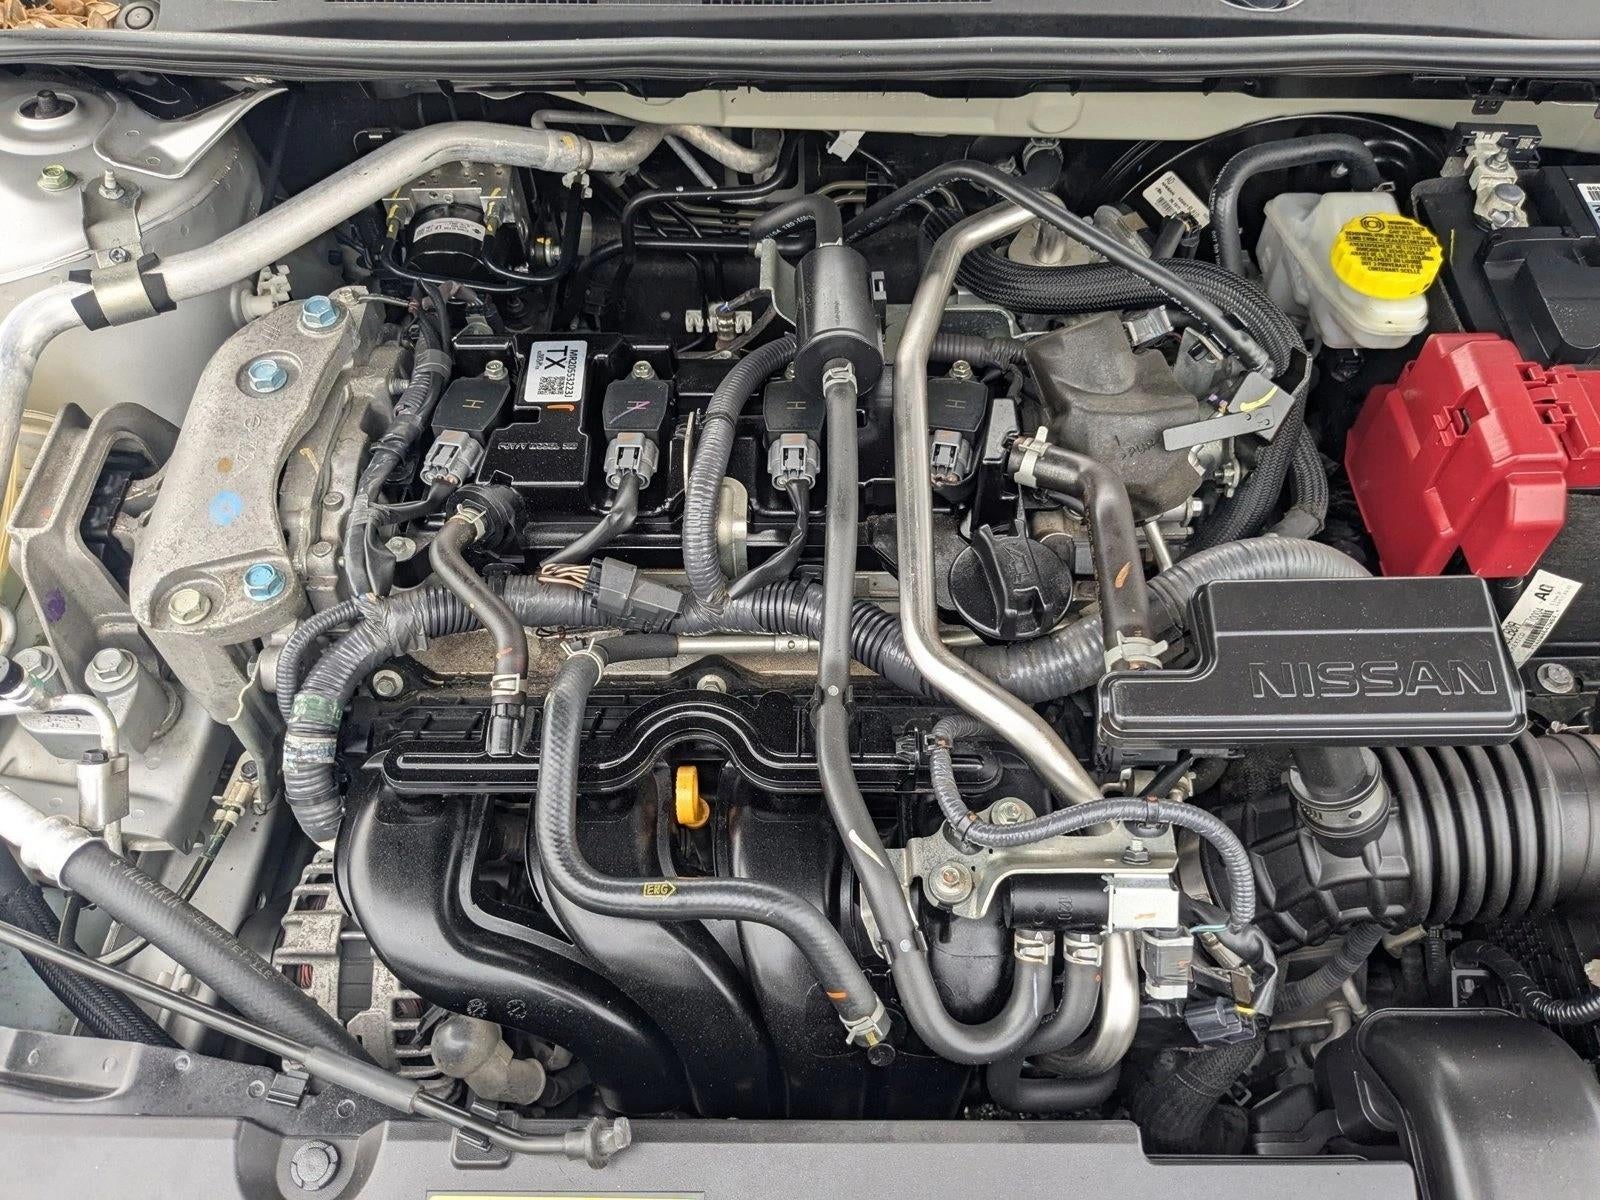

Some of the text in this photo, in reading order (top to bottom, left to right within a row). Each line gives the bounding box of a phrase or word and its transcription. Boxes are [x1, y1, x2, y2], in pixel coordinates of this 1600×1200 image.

[544, 345, 568, 370] TX
[1249, 660, 1498, 698] NISSAN
[646, 883, 669, 896] ENG
